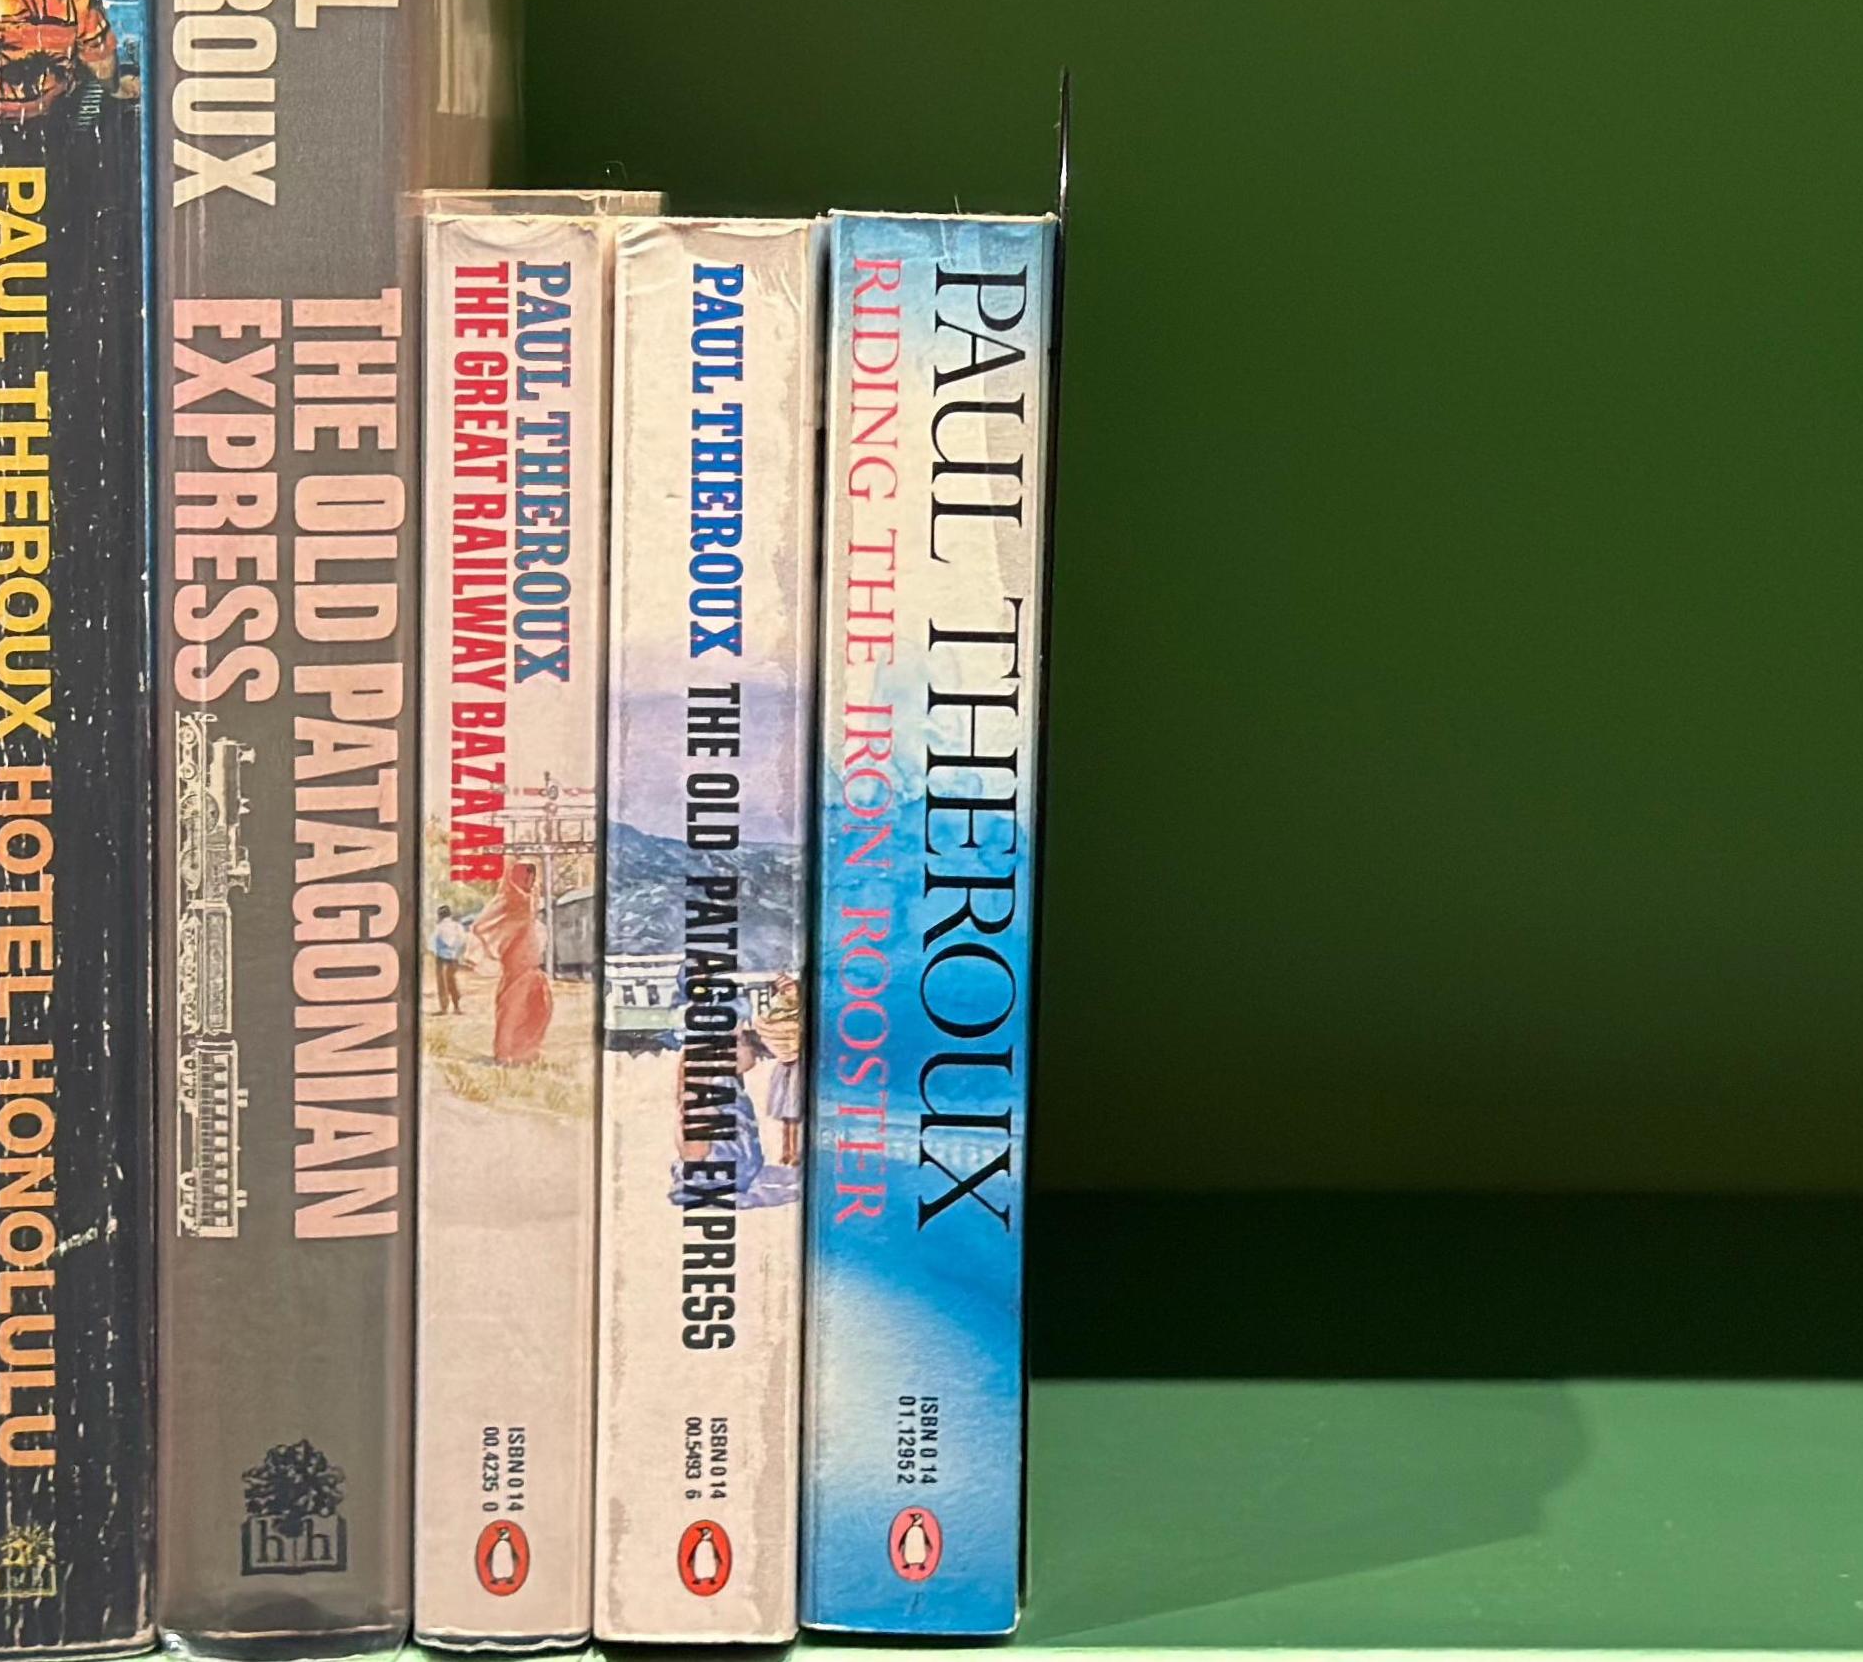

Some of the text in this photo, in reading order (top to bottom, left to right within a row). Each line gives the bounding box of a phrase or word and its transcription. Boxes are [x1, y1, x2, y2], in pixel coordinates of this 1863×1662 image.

[173, 298, 282, 703] EXPRESS
[450, 261, 509, 883] THE GREAT RAILWAY BAZAAR
[512, 260, 572, 684] PAUL THEROUX
[689, 263, 745, 658] PAUL THEROUX
[292, 287, 406, 1239] THE OLD PATAGONIAN
[834, 258, 904, 1223] RIDING THE IRON ROOSTER
[917, 262, 1028, 1233] PAUL THEROUX
[682, 682, 741, 1350] THE OLD PATAGONIAN EXPRESS
[507, 1427, 525, 1473] ISBN
[507, 1493, 525, 1511] 14
[709, 1481, 727, 1499] 14
[710, 1417, 728, 1462] ISBN
[920, 1396, 939, 1442] ISBN
[920, 1464, 938, 1484] 14
